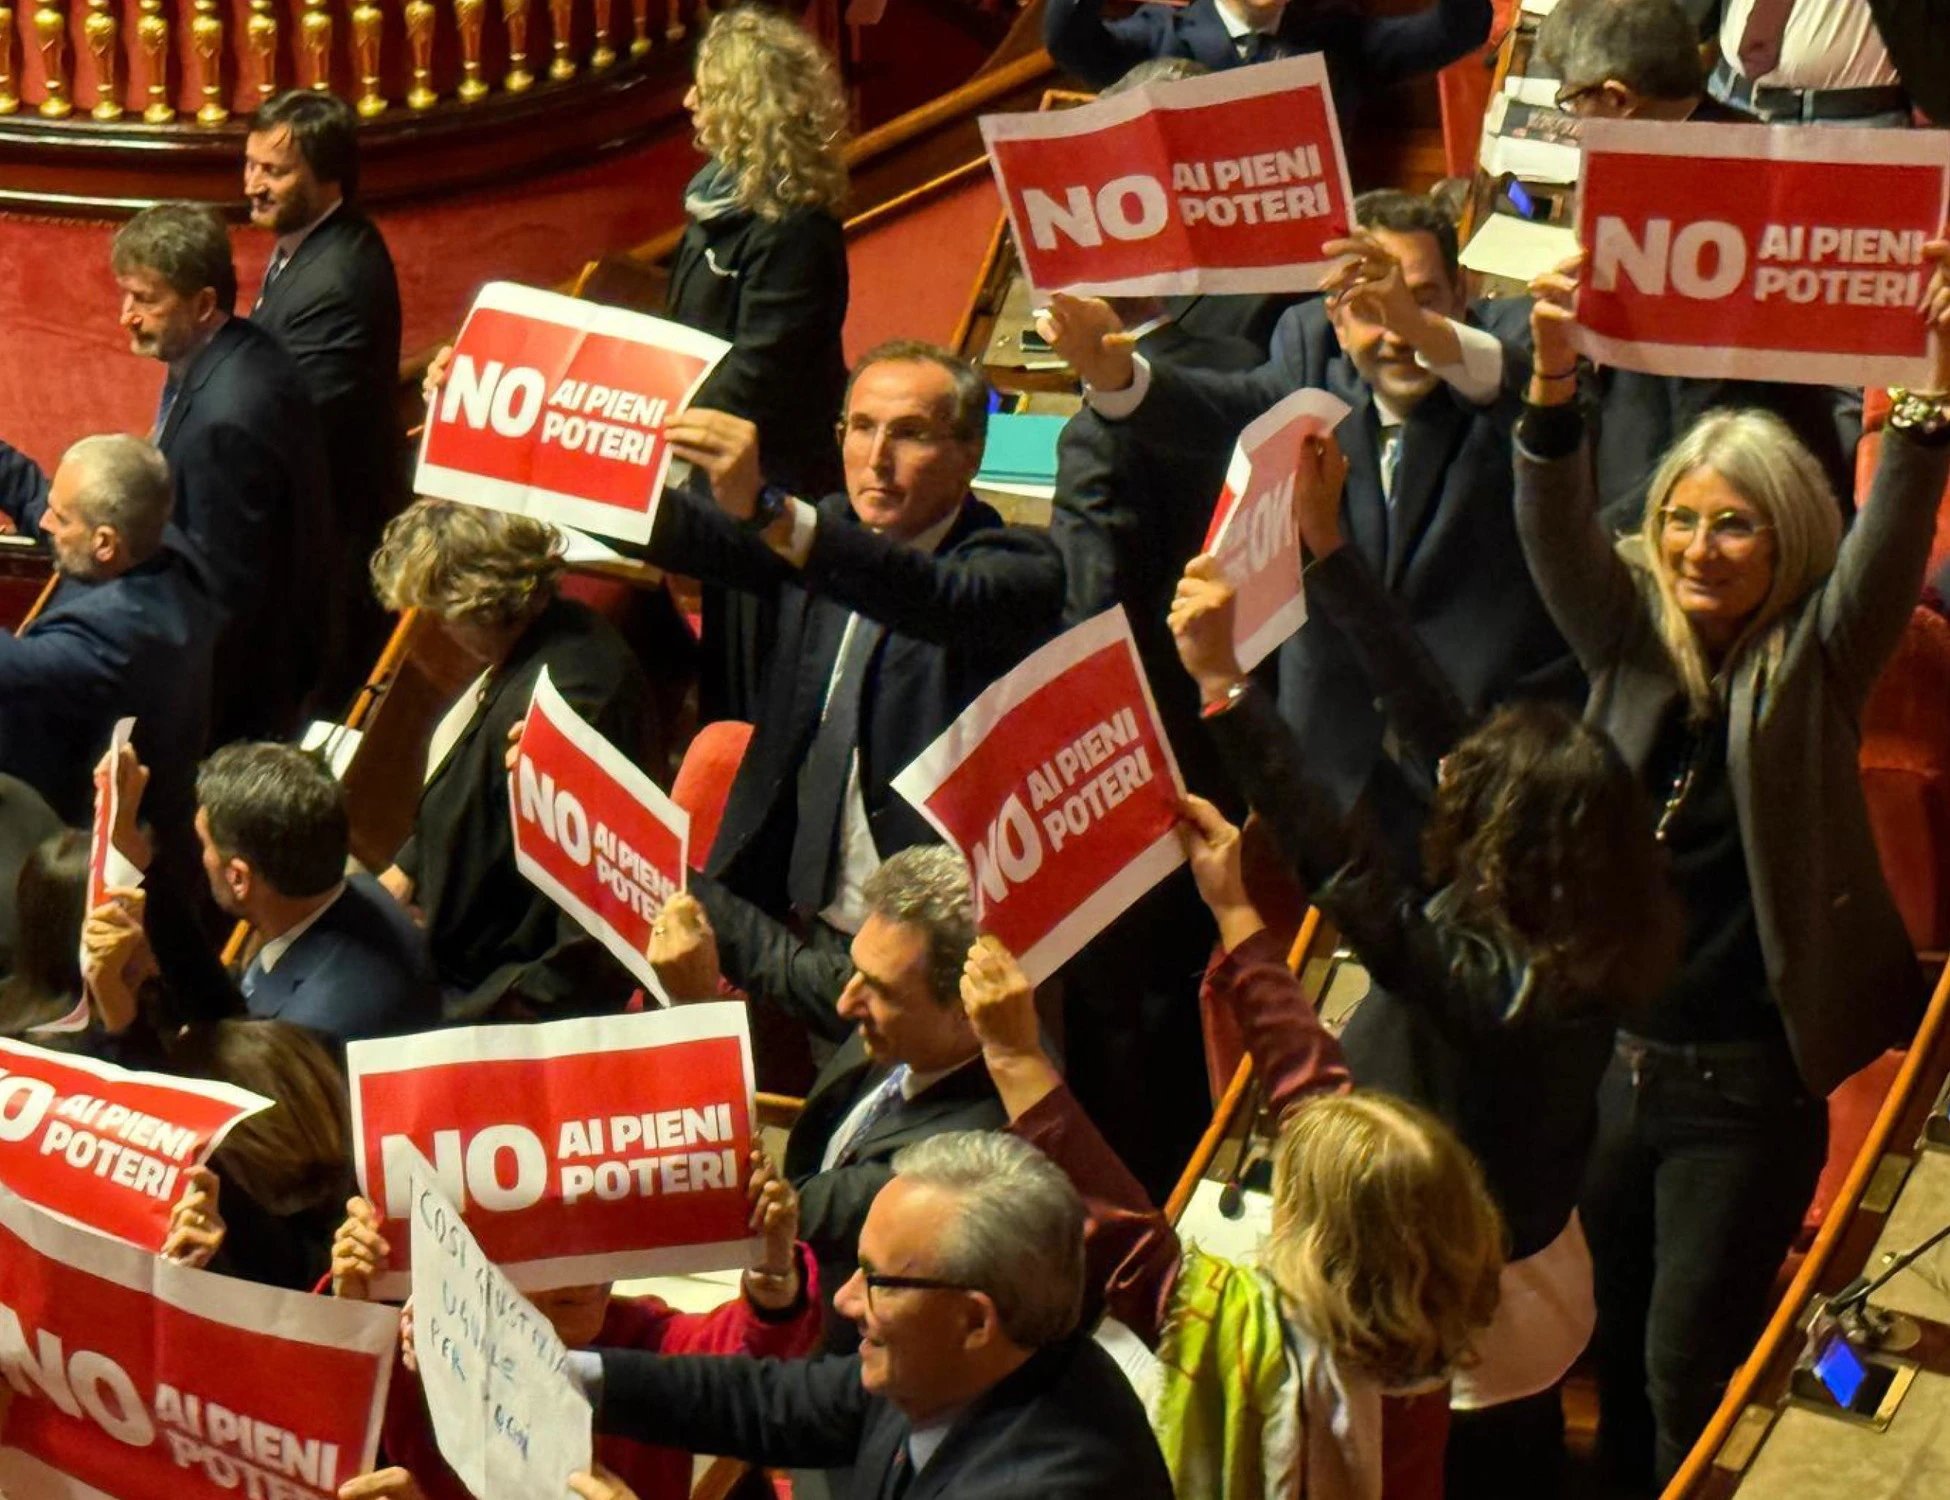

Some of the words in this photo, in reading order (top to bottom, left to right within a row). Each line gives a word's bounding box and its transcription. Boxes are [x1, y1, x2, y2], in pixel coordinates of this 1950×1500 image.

[1172, 161, 1210, 193] AI
[1213, 143, 1323, 191] PIENI
[1177, 182, 1332, 228] POTERI
[1021, 174, 1169, 251] NO
[1757, 224, 1805, 261] AI
[1808, 226, 1927, 265] PIENI
[1591, 215, 1747, 300] NO
[1754, 265, 1922, 307] POTERI
[440, 354, 546, 438] NO
[547, 379, 586, 411] AI
[582, 383, 668, 428] PIENI
[540, 411, 657, 467] POTERI
[1025, 760, 1066, 812] AI
[1054, 706, 1141, 788] PIENI
[518, 752, 592, 867] NO
[1042, 745, 1154, 853] POTERI
[594, 821, 617, 862] AI
[971, 792, 1043, 923] NO
[0, 1068, 56, 1142] O
[56, 1094, 107, 1125] AI
[96, 1103, 198, 1161] PIENI
[558, 1118, 602, 1160] AI
[610, 1102, 734, 1153] PIENI
[40, 1119, 180, 1201] POTERI
[381, 1124, 548, 1219] NO
[559, 1149, 739, 1205] POTERI
[0, 1302, 156, 1447] NO
[155, 1383, 202, 1438] AI
[205, 1401, 340, 1491] PIENI
